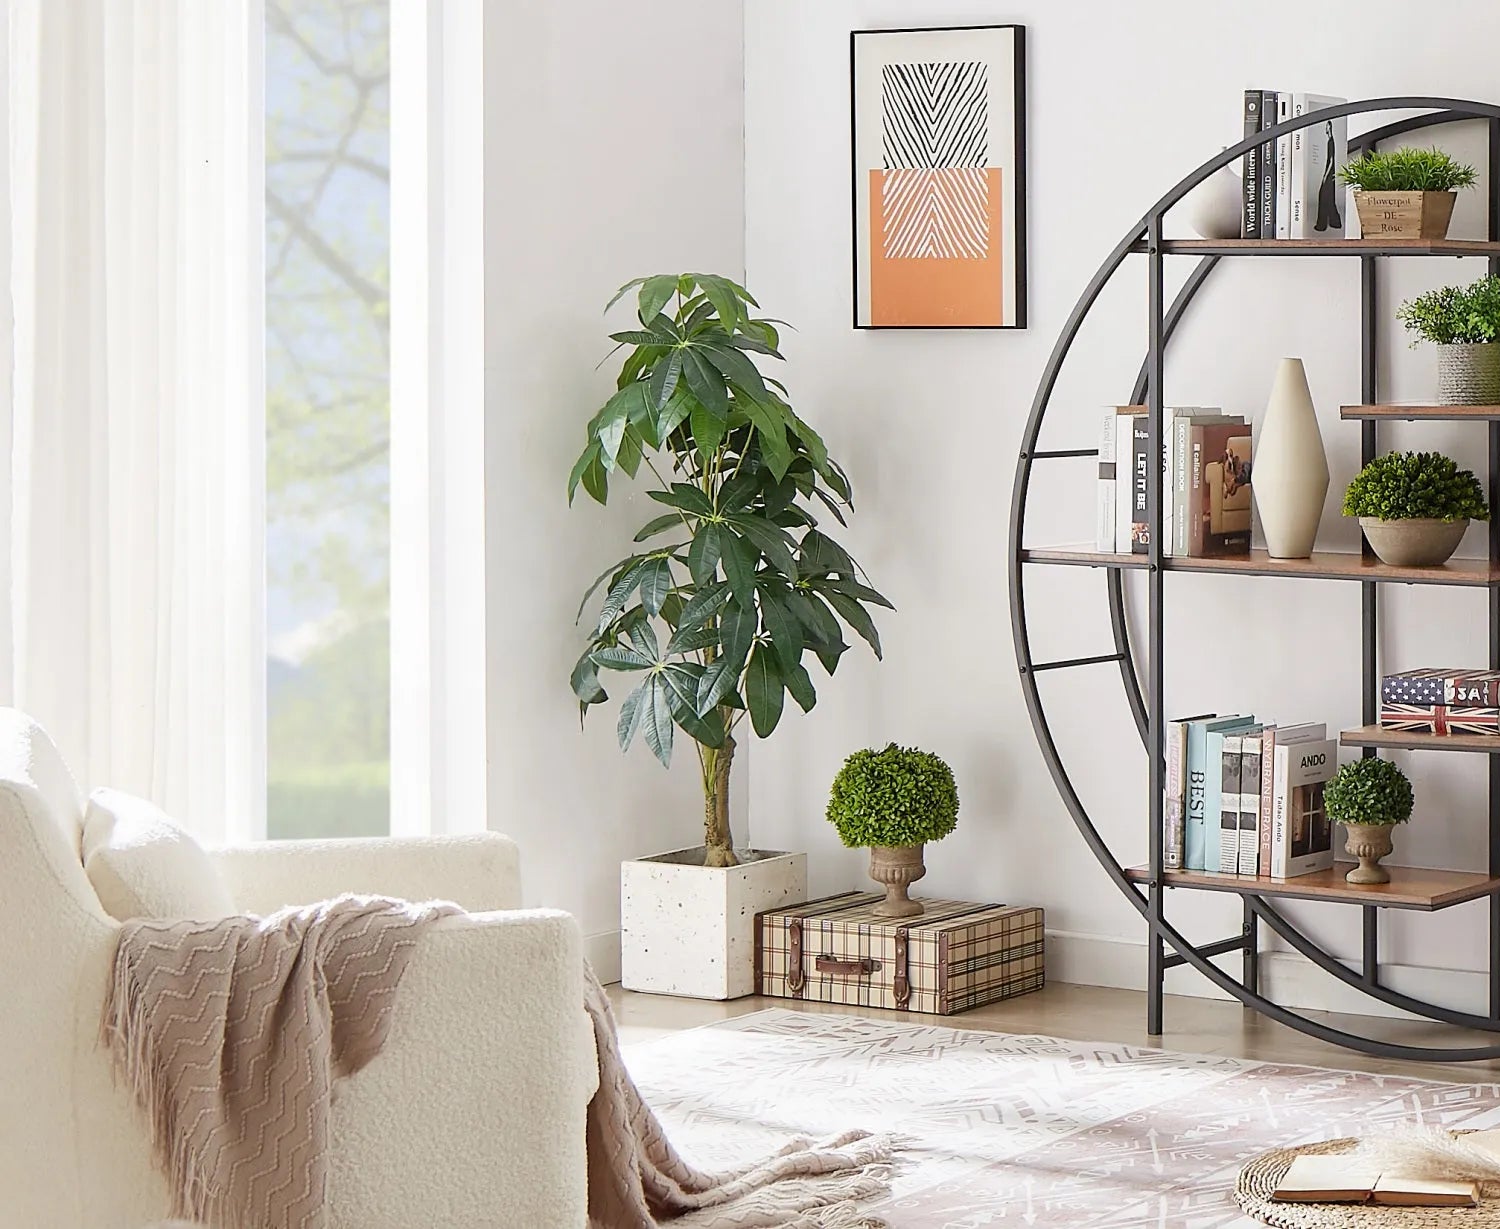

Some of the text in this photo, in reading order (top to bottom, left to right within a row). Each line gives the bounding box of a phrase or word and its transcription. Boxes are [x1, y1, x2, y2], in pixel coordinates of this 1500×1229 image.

[1247, 148, 1255, 232] World wide intern
[1368, 197, 1410, 207] Flowerpot
[1381, 224, 1403, 232] Rose
[1137, 453, 1146, 510] LET IT BE
[1301, 753, 1326, 768] ANDO
[1189, 771, 1204, 825] BEST
[1262, 738, 1271, 850] WYBRANE PRACE
